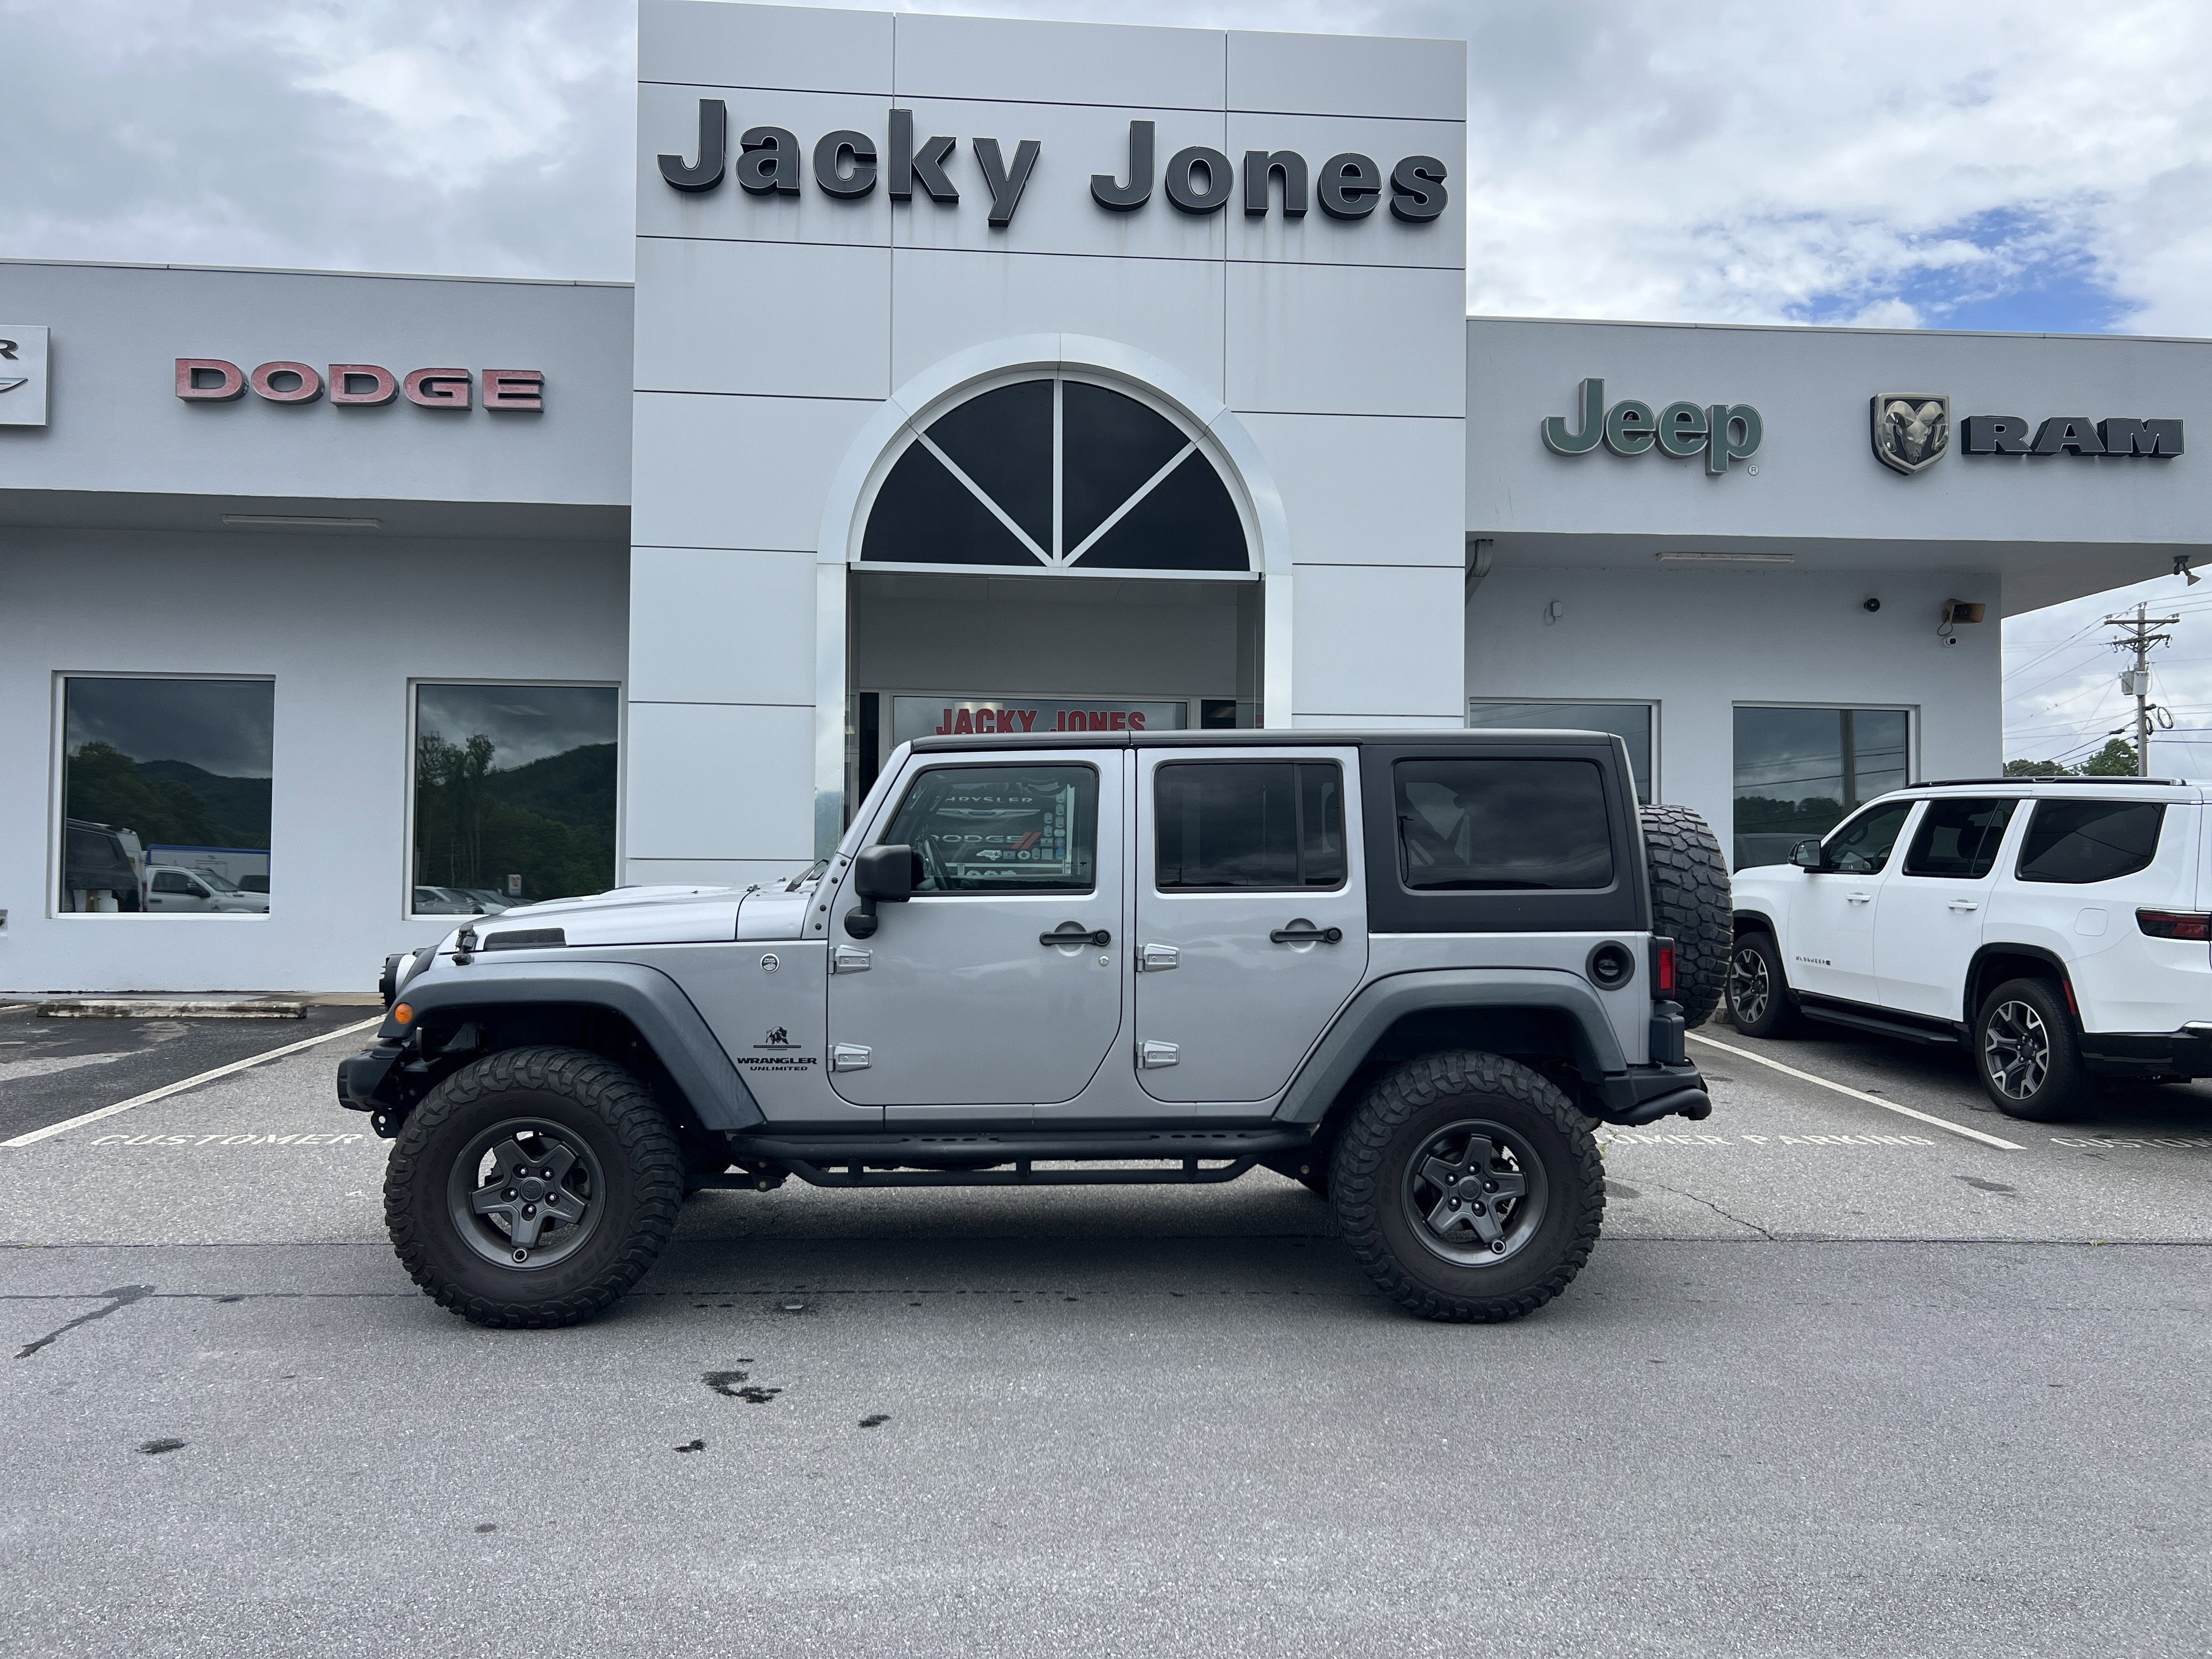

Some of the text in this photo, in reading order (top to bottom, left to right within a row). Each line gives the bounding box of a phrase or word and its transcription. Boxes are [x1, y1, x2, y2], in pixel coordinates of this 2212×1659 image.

[657, 99, 1448, 227] Jacky Jones
[175, 358, 545, 413] DODGE
[1541, 378, 1764, 476] Jeep
[1960, 415, 2185, 458] RAM
[936, 708, 1146, 735] JACKY JONES
[90, 1134, 364, 1145] CUSTOMER
